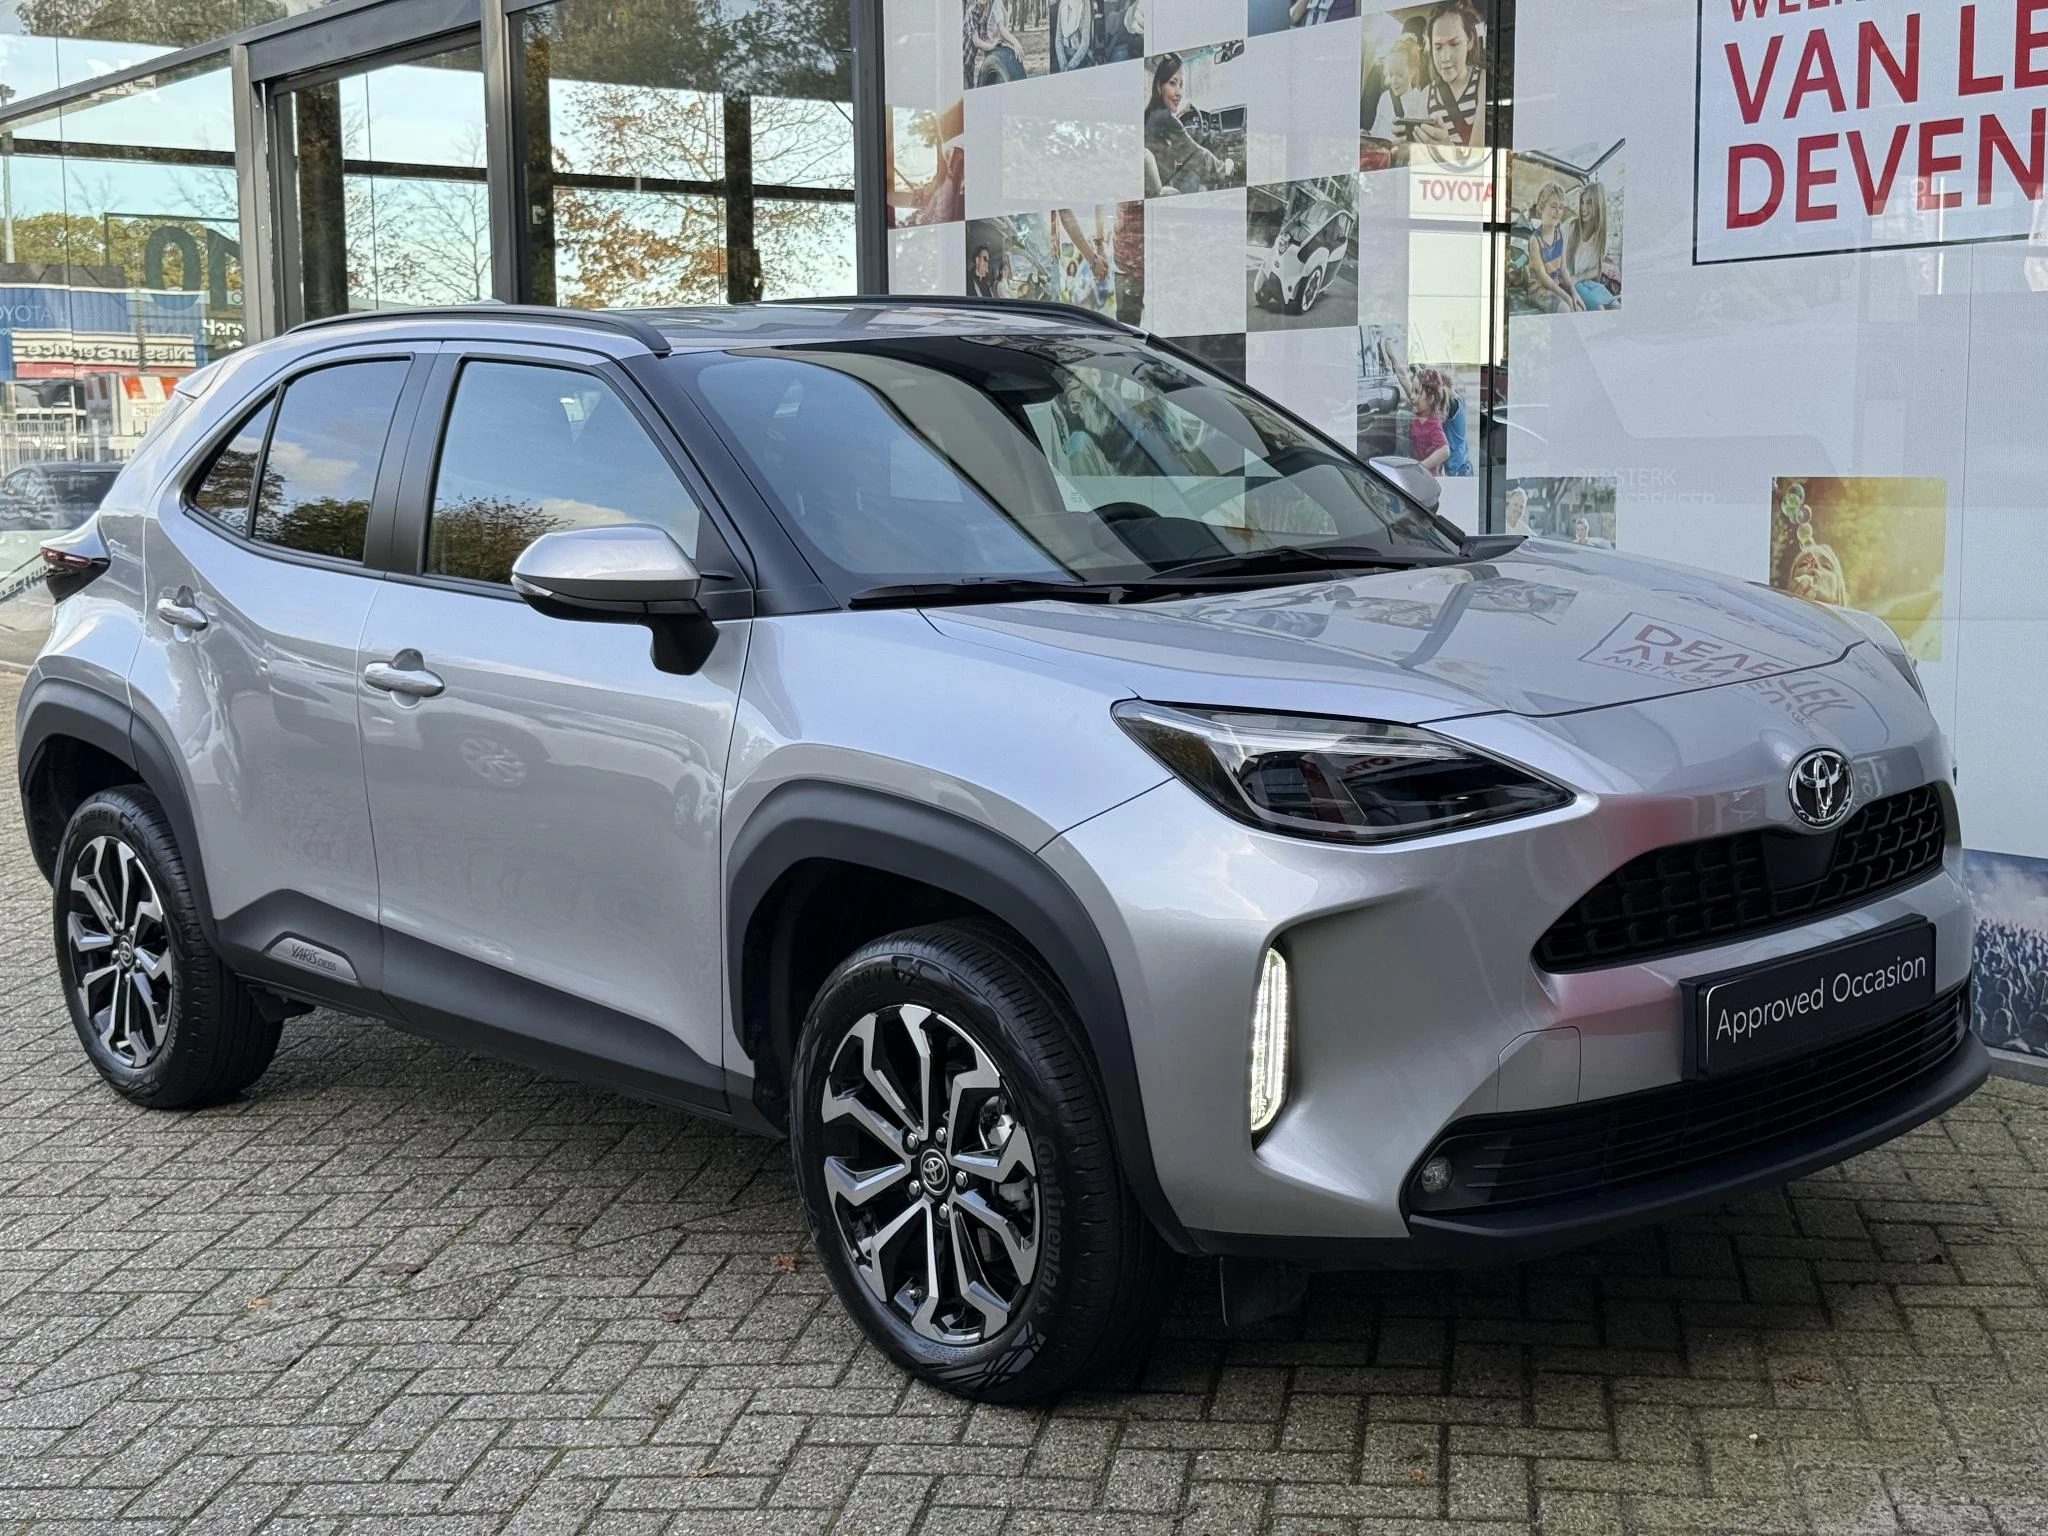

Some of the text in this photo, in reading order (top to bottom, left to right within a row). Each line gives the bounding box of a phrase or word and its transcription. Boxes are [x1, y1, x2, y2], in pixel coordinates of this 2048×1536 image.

[1724, 0, 2048, 125] VAN LE
[1419, 180, 1495, 203] TOYOTA
[1726, 107, 2048, 230] DEVEN
[1716, 955, 1927, 1043] Approved Occasion
